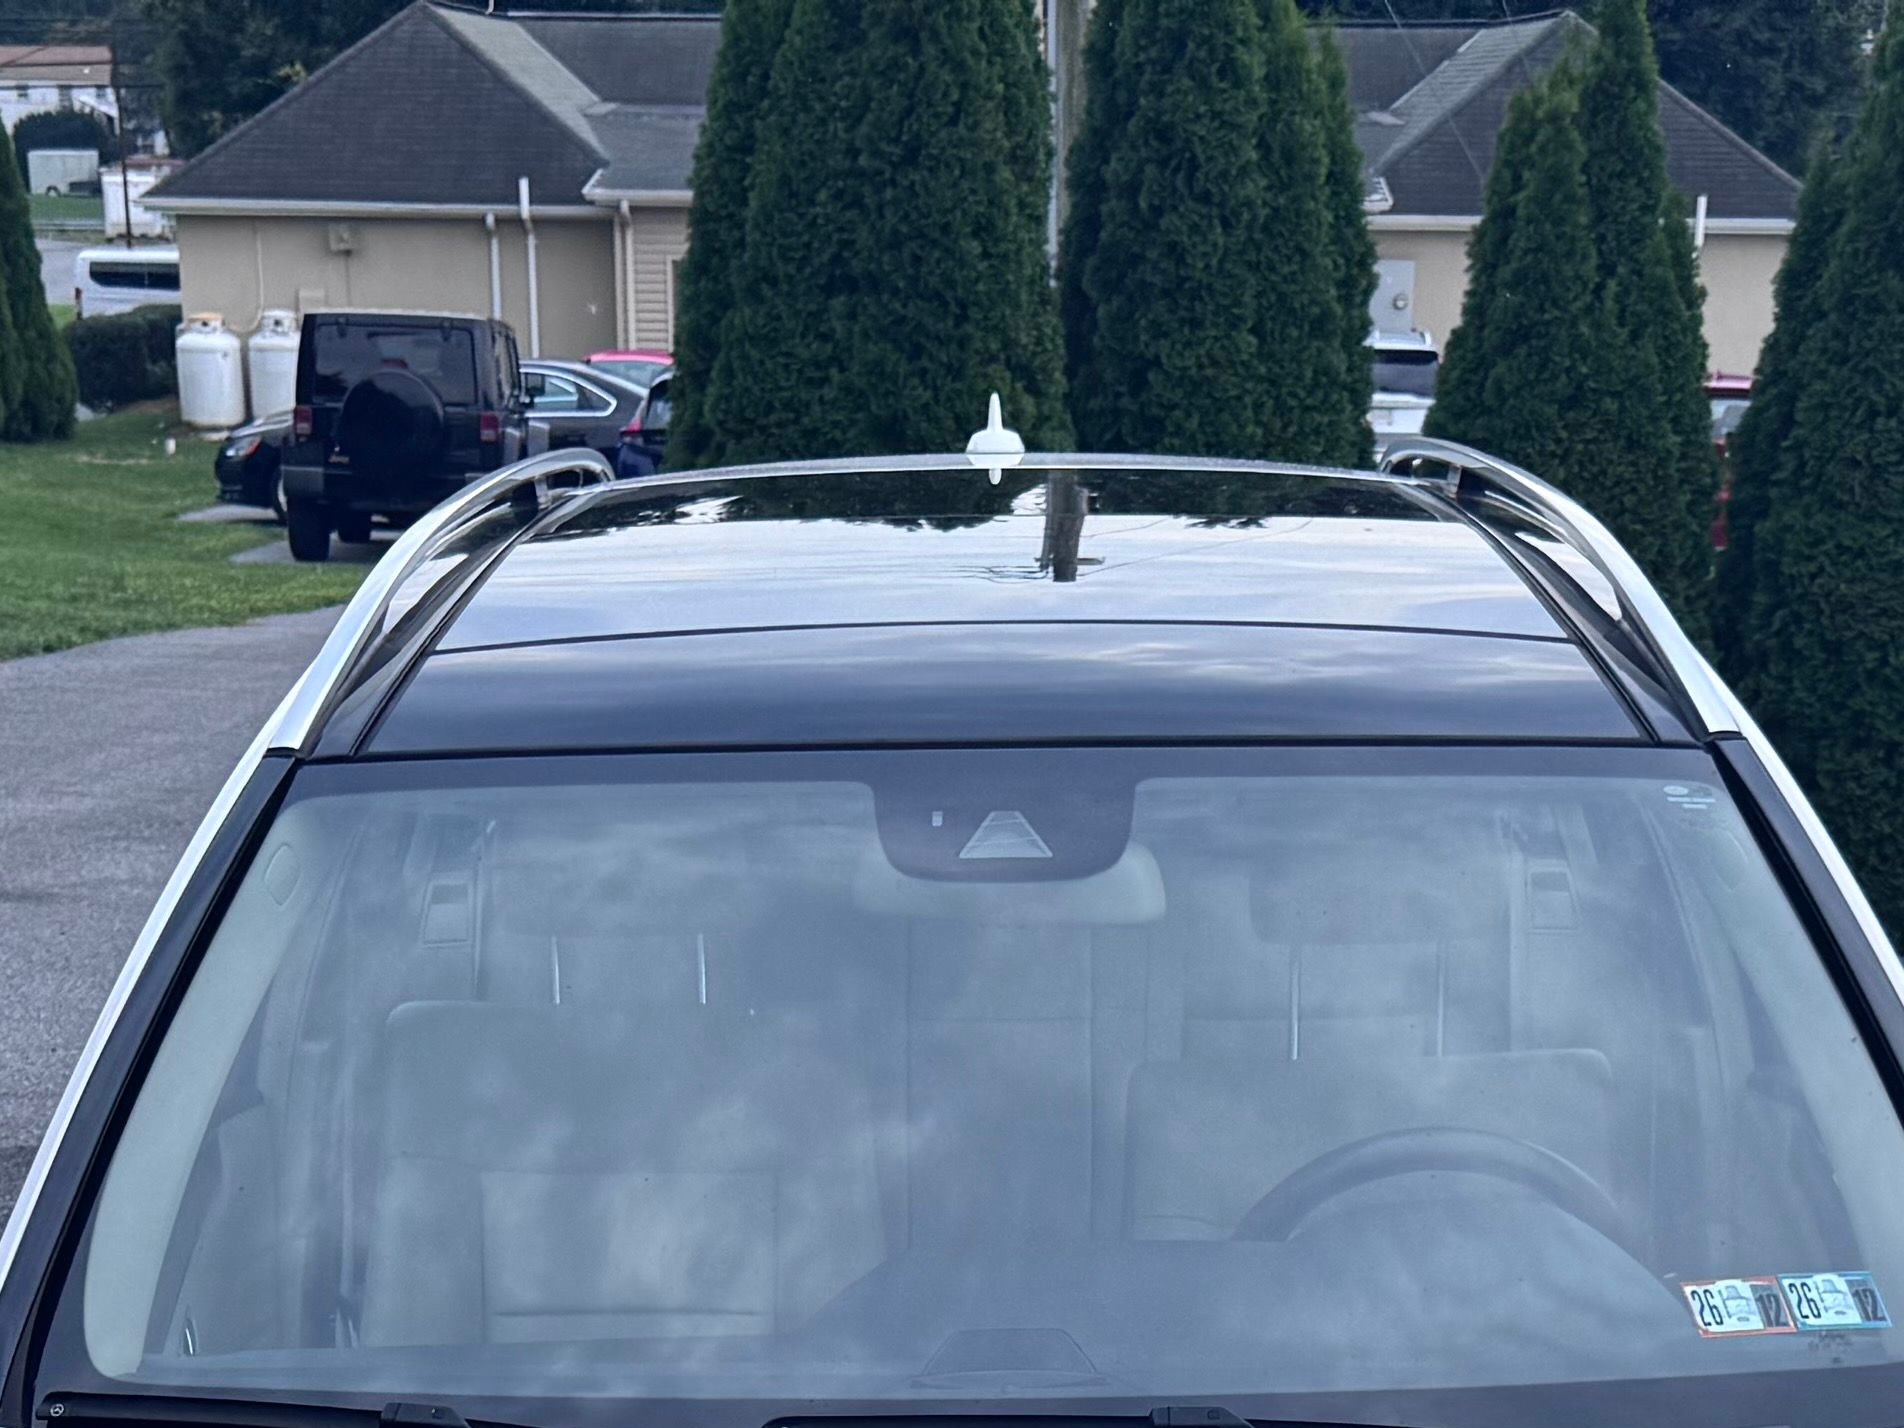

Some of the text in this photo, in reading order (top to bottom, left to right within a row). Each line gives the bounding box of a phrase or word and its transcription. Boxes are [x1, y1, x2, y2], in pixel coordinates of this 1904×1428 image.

[1690, 1288, 1791, 1328] 26 12
[1788, 1281, 1887, 1322] 26 12
